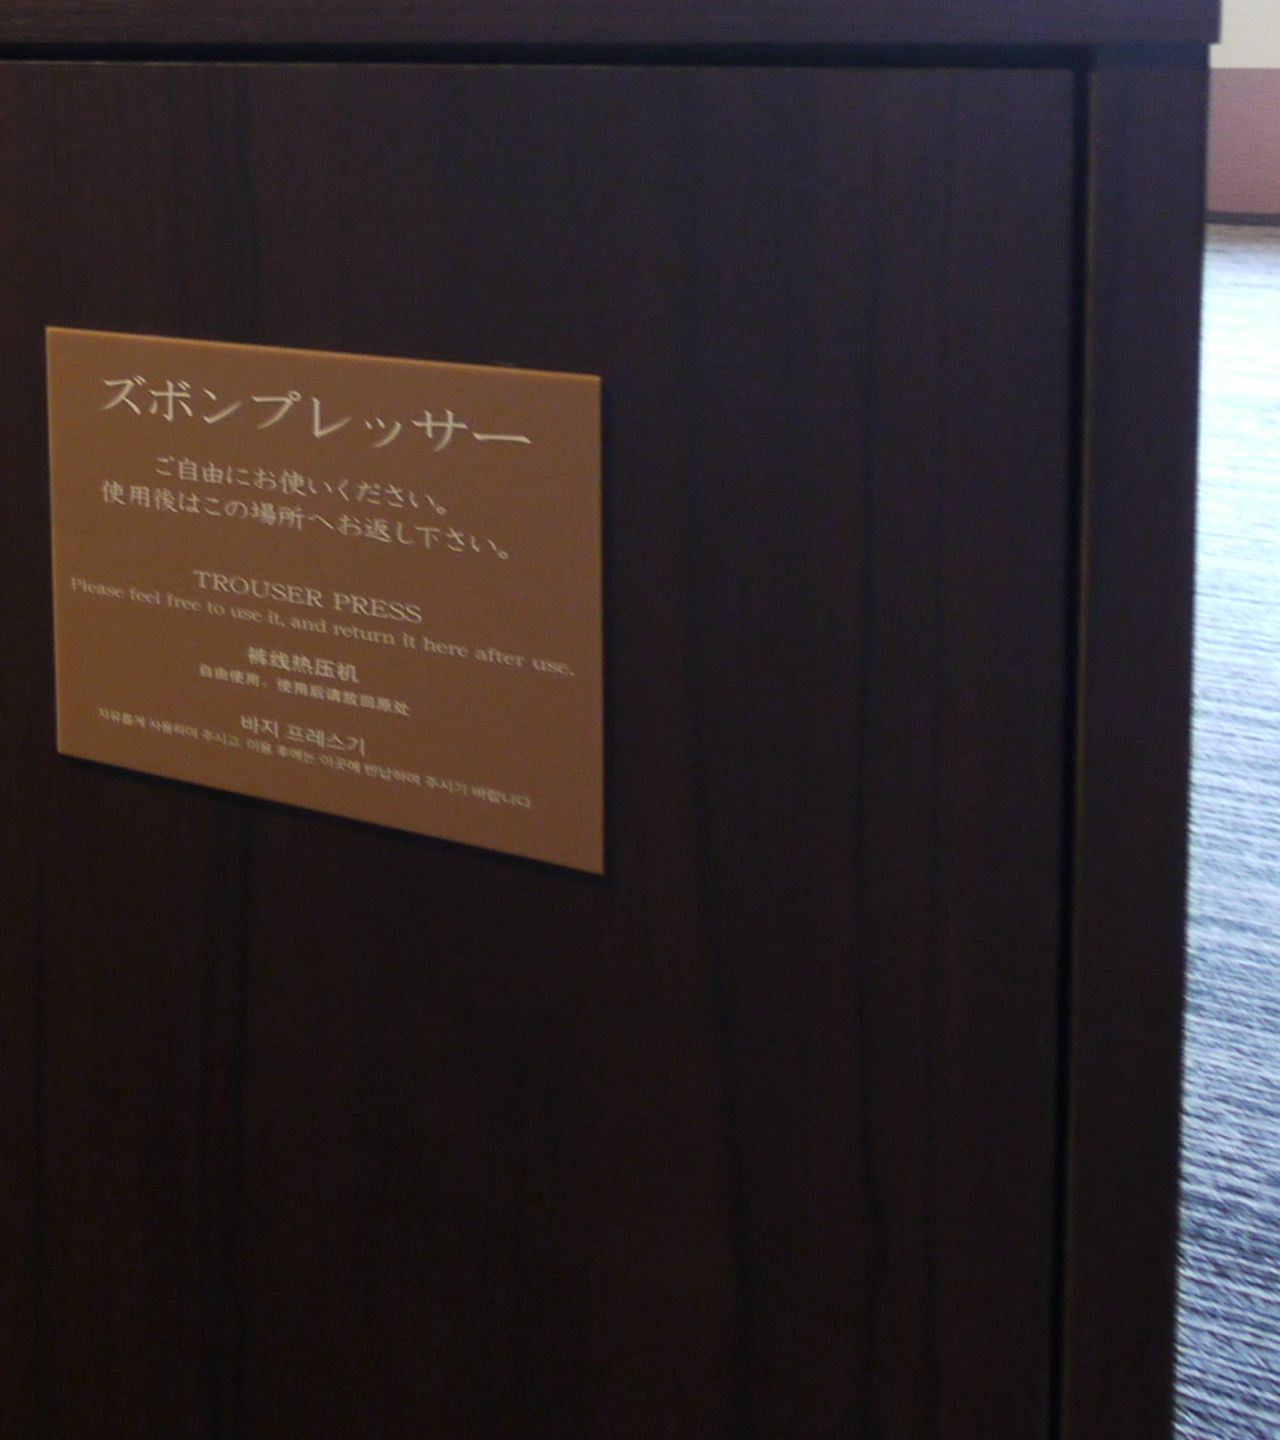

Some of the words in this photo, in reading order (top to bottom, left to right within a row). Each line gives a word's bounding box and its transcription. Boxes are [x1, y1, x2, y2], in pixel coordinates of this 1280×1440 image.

[101, 375, 532, 452] ズボンプレッサー
[155, 456, 447, 515] ご自由にお使いください。
[101, 480, 509, 560] 使用後はこの場所へお返し下さい。
[70, 576, 125, 600] Please
[130, 585, 161, 606] feel
[167, 593, 201, 612] free
[207, 601, 226, 616] to
[231, 607, 263, 623] use
[290, 615, 328, 634] and
[333, 624, 395, 646] return
[402, 632, 418, 650] it
[423, 636, 469, 658] here
[474, 646, 527, 668] after
[532, 658, 576, 677] use.
[193, 570, 324, 609] TROUSER
[333, 592, 423, 624] PRESS
[241, 714, 280, 738] 바지
[287, 723, 366, 757] 프레스기
[364, 762, 422, 786] 반납하여
[424, 774, 469, 797] 주시기
